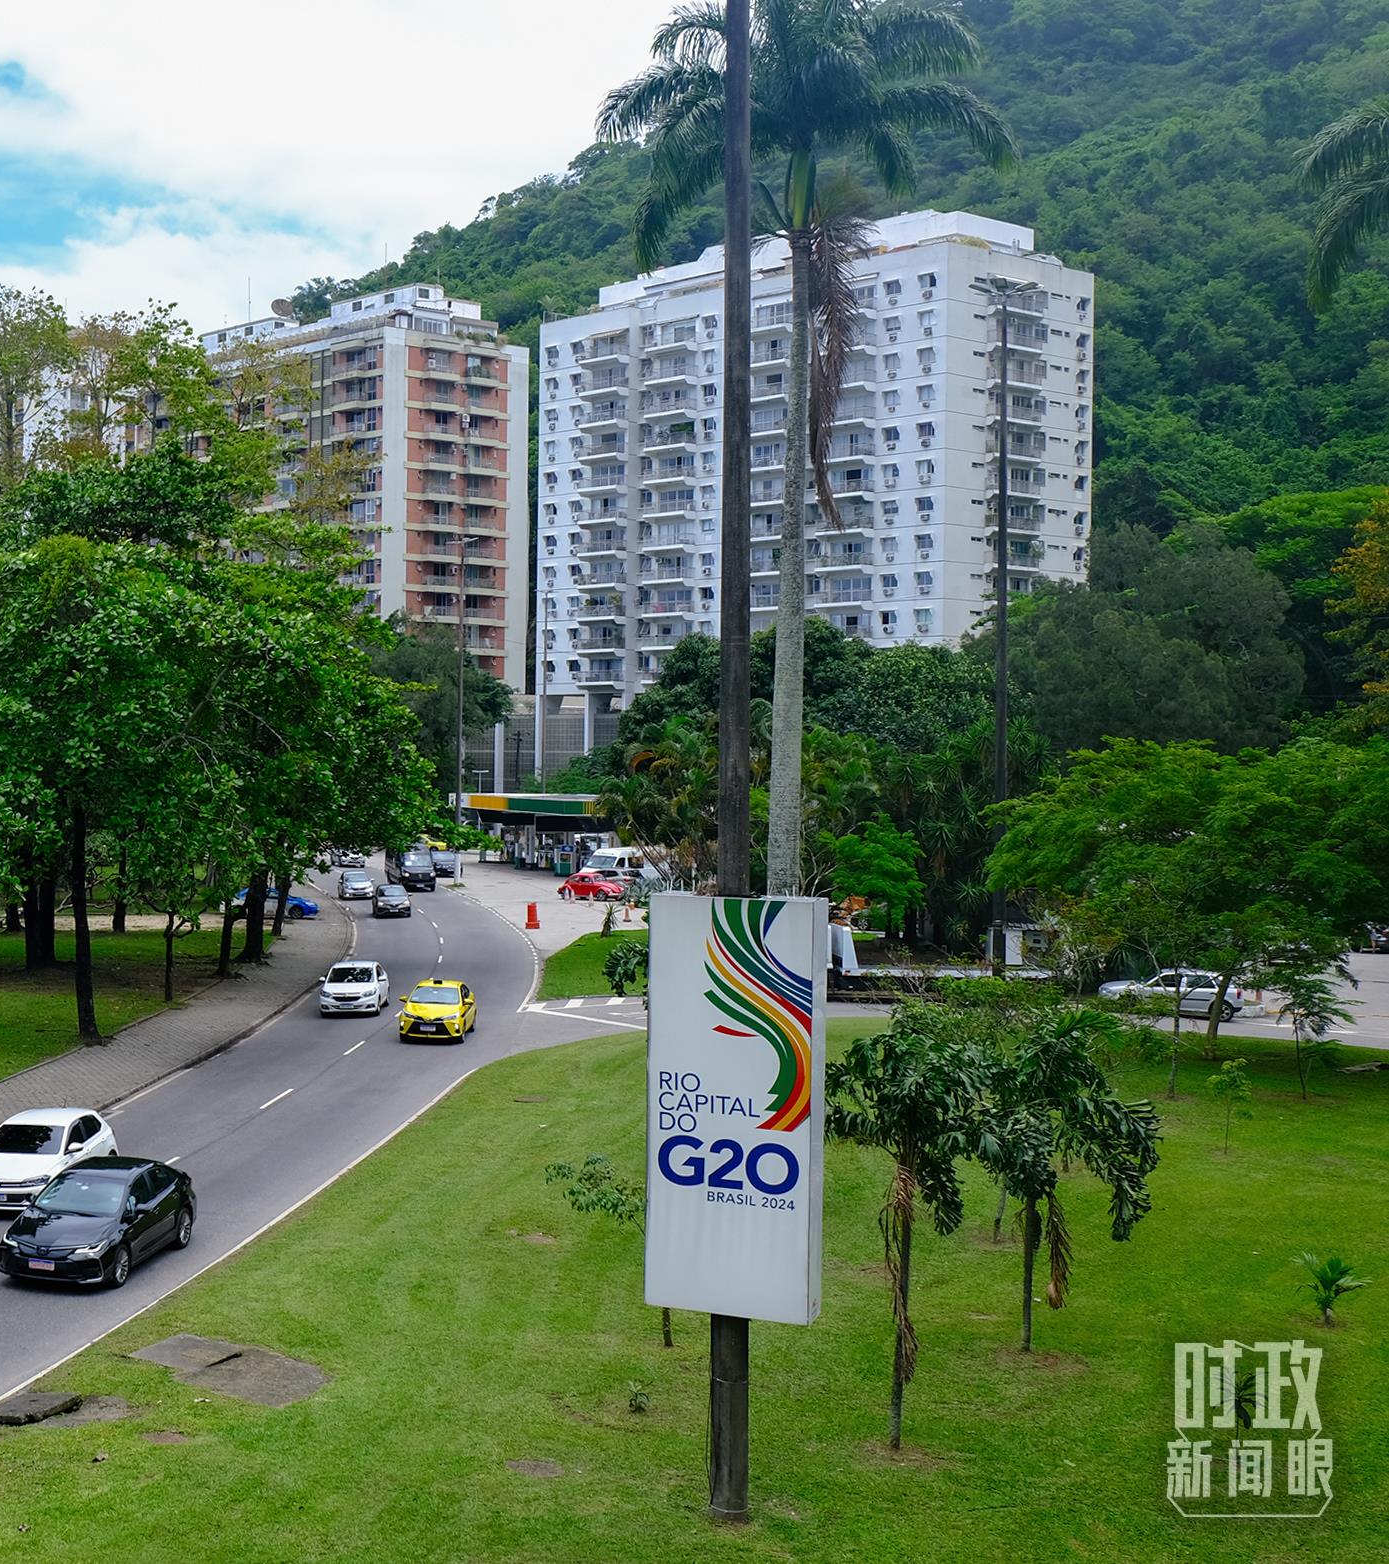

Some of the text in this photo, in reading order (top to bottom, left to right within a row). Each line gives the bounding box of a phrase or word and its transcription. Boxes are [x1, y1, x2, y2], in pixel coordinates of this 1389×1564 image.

[659, 1071, 701, 1092] RIO
[658, 1091, 761, 1118] CAPITAL
[659, 1111, 697, 1133] DO
[658, 1135, 800, 1195] G20
[707, 1191, 795, 1211] BRASIL 2024
